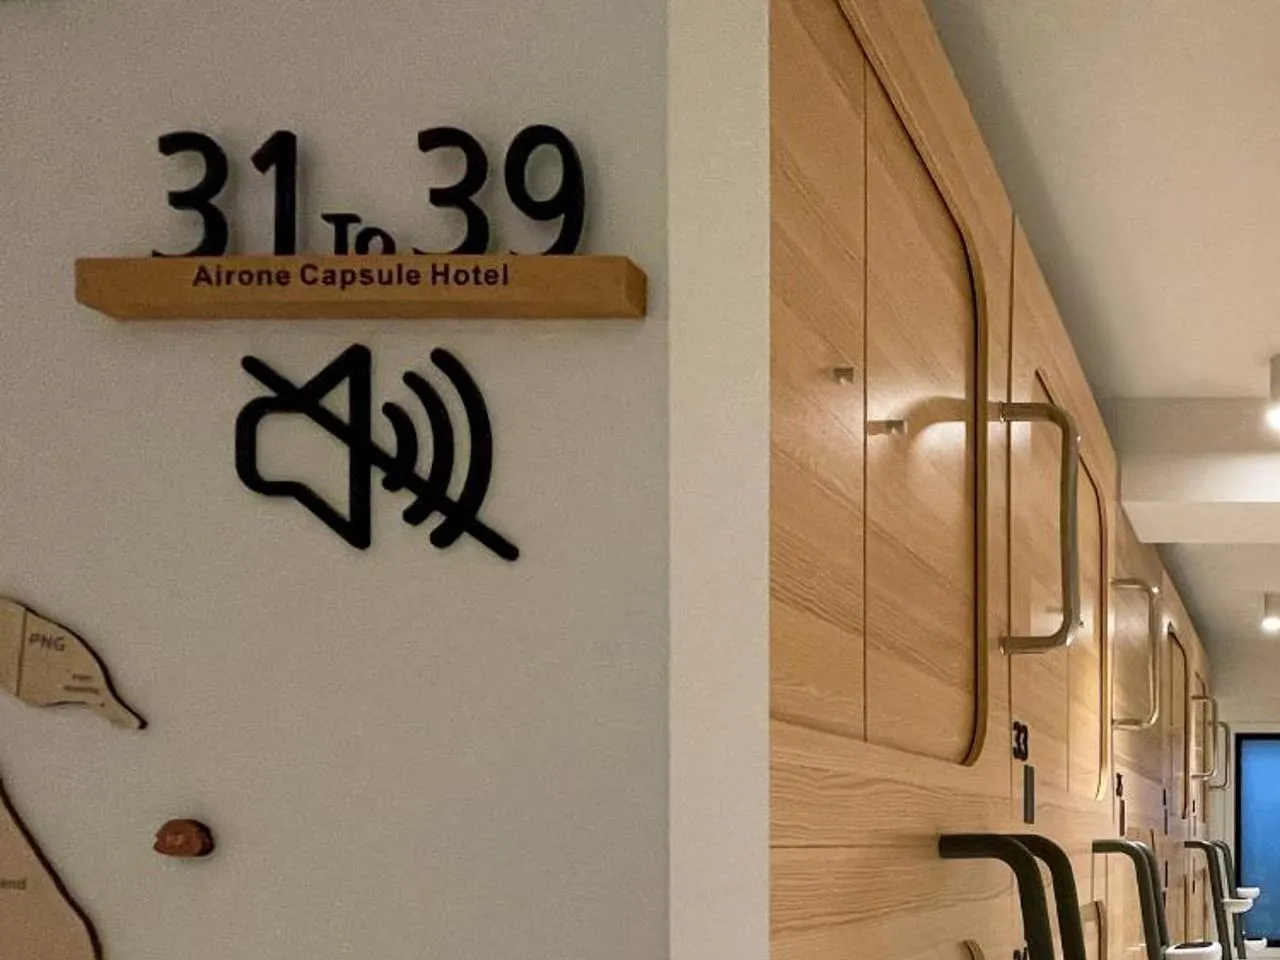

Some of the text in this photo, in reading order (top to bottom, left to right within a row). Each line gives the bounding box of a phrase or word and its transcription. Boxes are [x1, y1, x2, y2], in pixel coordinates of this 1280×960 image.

[152, 124, 585, 256] 31 To 39
[191, 262, 509, 290] Airone Capsule Hotel
[29, 632, 66, 652] PNG
[1013, 721, 1028, 761] 33
